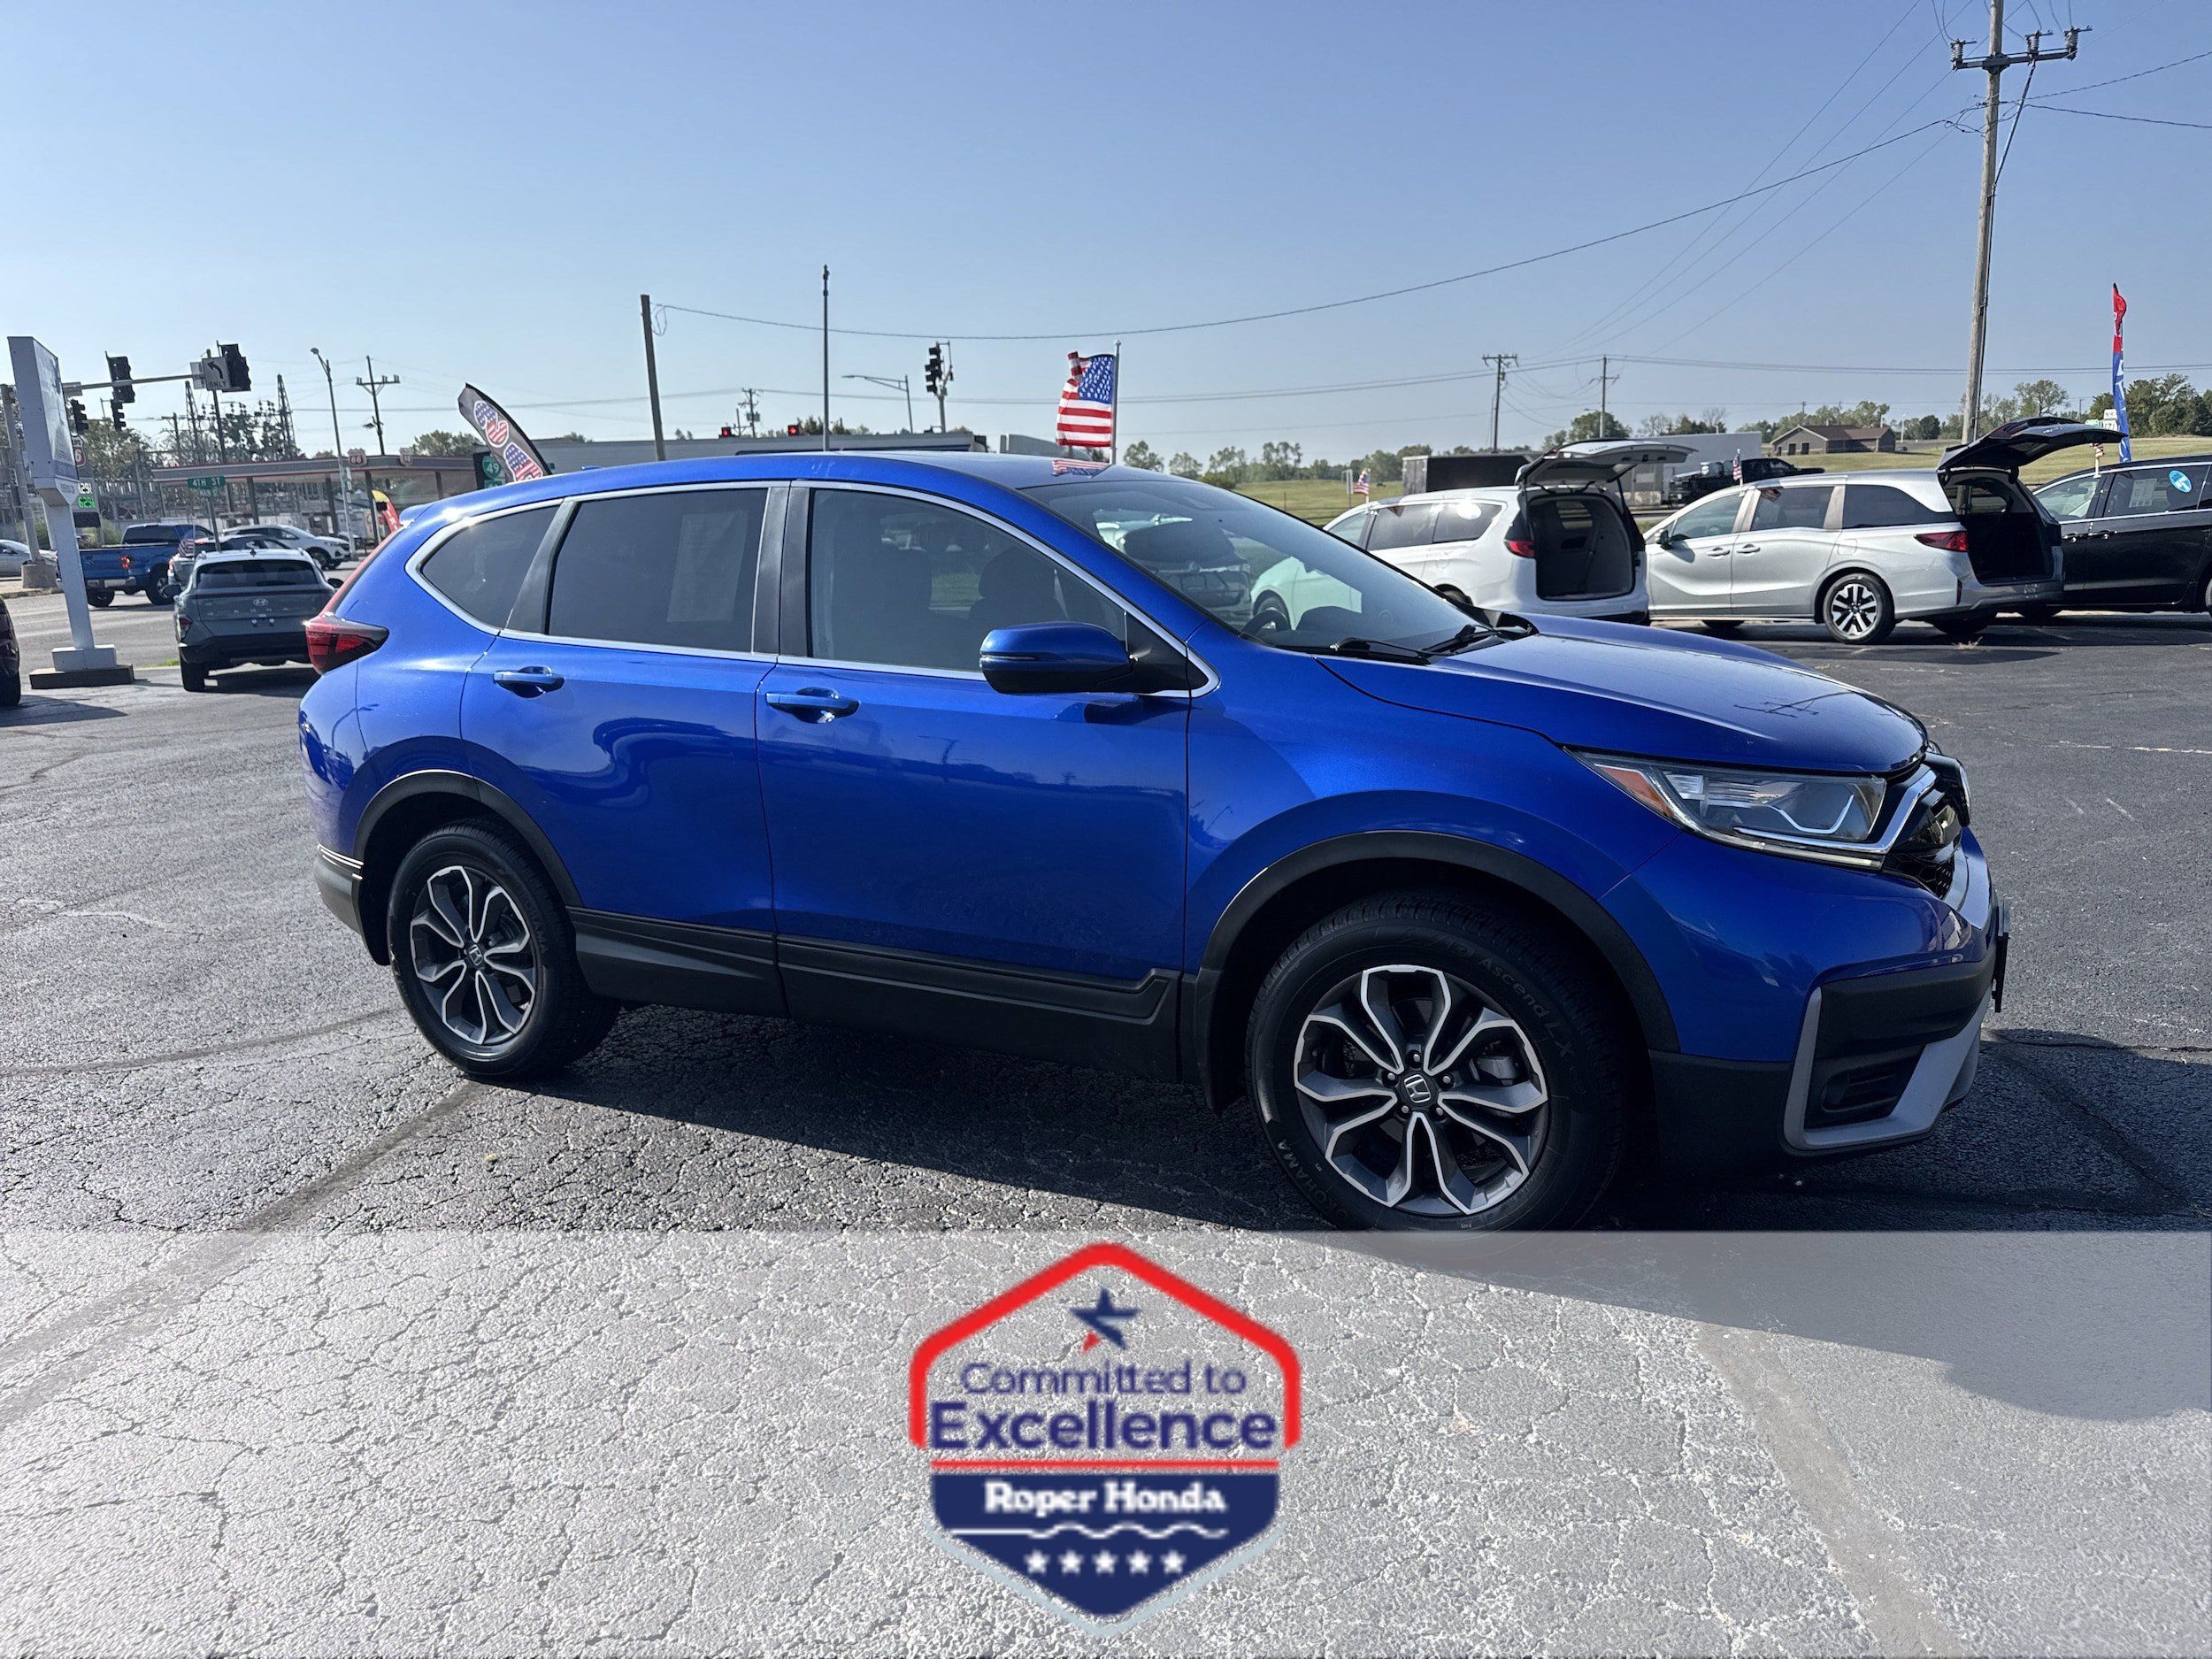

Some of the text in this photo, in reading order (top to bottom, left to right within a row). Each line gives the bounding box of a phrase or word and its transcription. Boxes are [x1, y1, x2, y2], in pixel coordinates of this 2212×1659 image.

[487, 463, 500, 473] 49
[192, 477, 220, 487] 4TH ST
[1478, 956, 1551, 1018] Ascend
